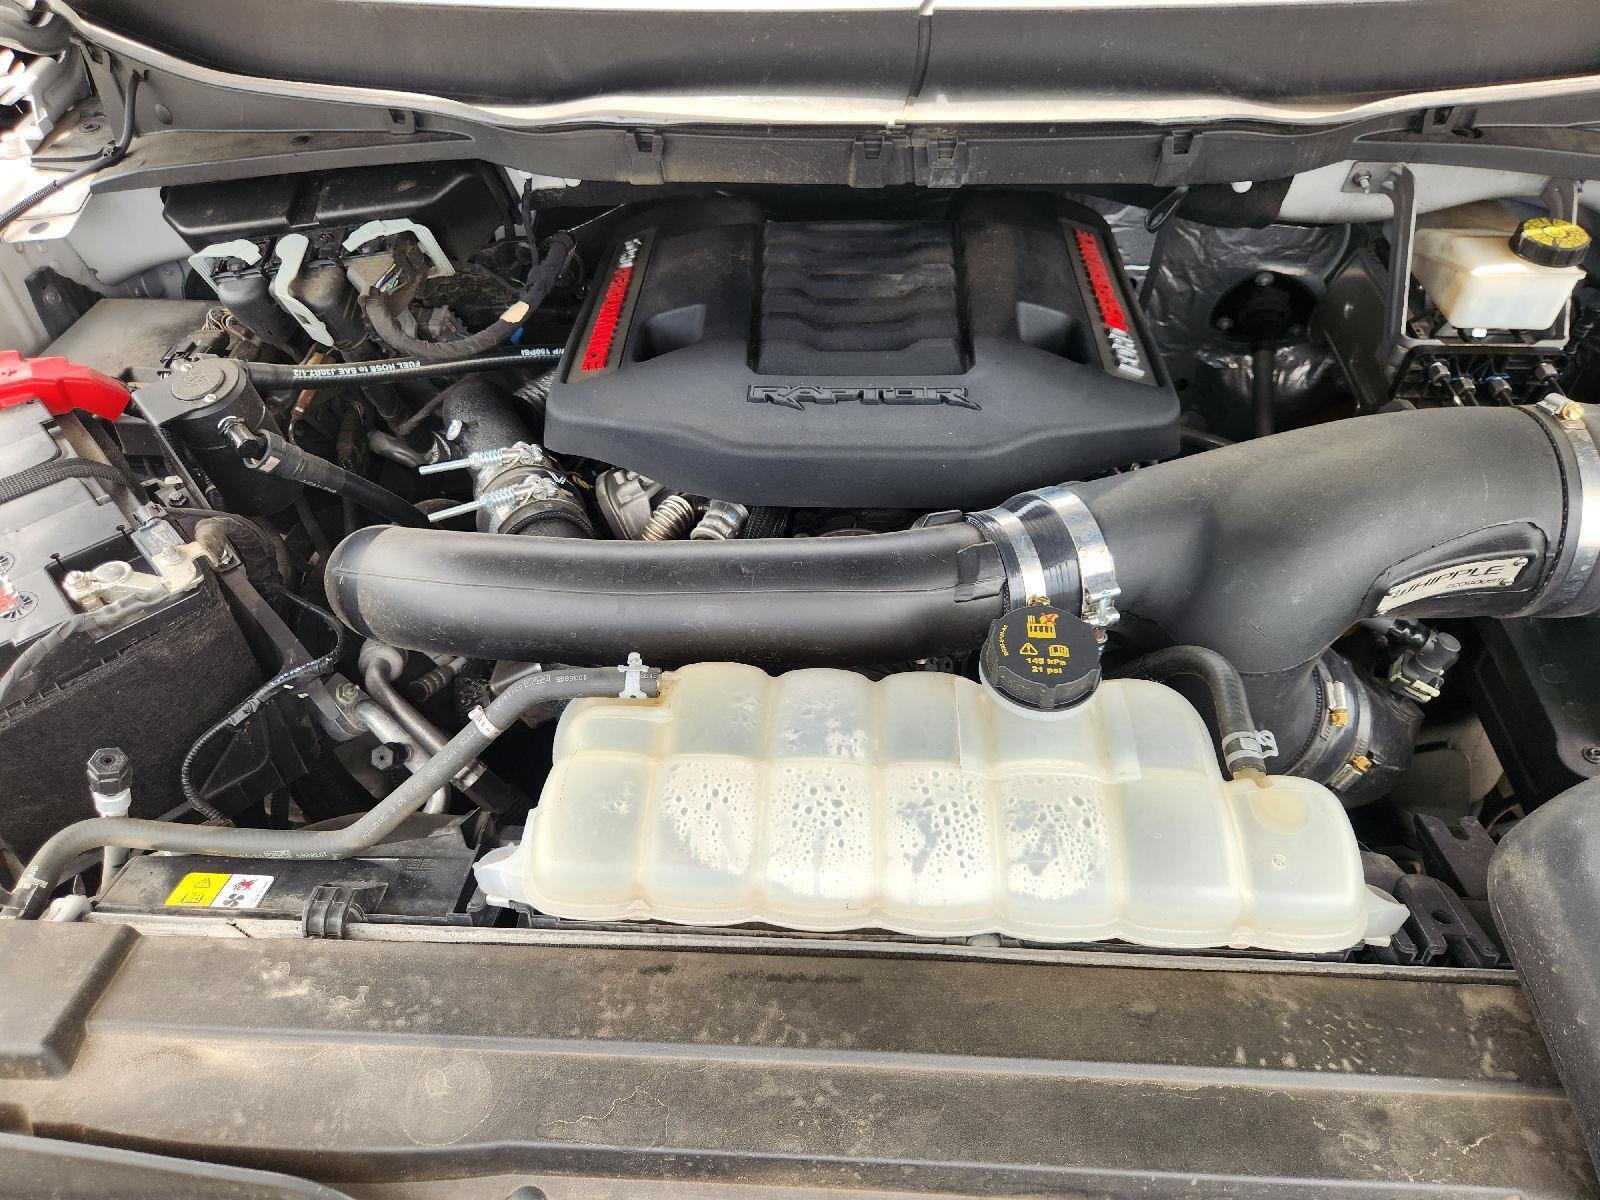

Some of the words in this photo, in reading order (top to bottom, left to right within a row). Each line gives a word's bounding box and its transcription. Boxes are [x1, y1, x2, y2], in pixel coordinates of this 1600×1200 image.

[359, 365, 369, 373] to
[370, 363, 396, 373] HOSE
[397, 360, 421, 369] FUEL
[338, 367, 357, 376] SAE
[747, 384, 983, 412] RAPTOR
[1392, 564, 1507, 599] WHIPPLE
[1025, 657, 1045, 666] 145
[1046, 658, 1067, 667] kPa
[1031, 665, 1044, 674] 21
[1046, 667, 1063, 675] psi
